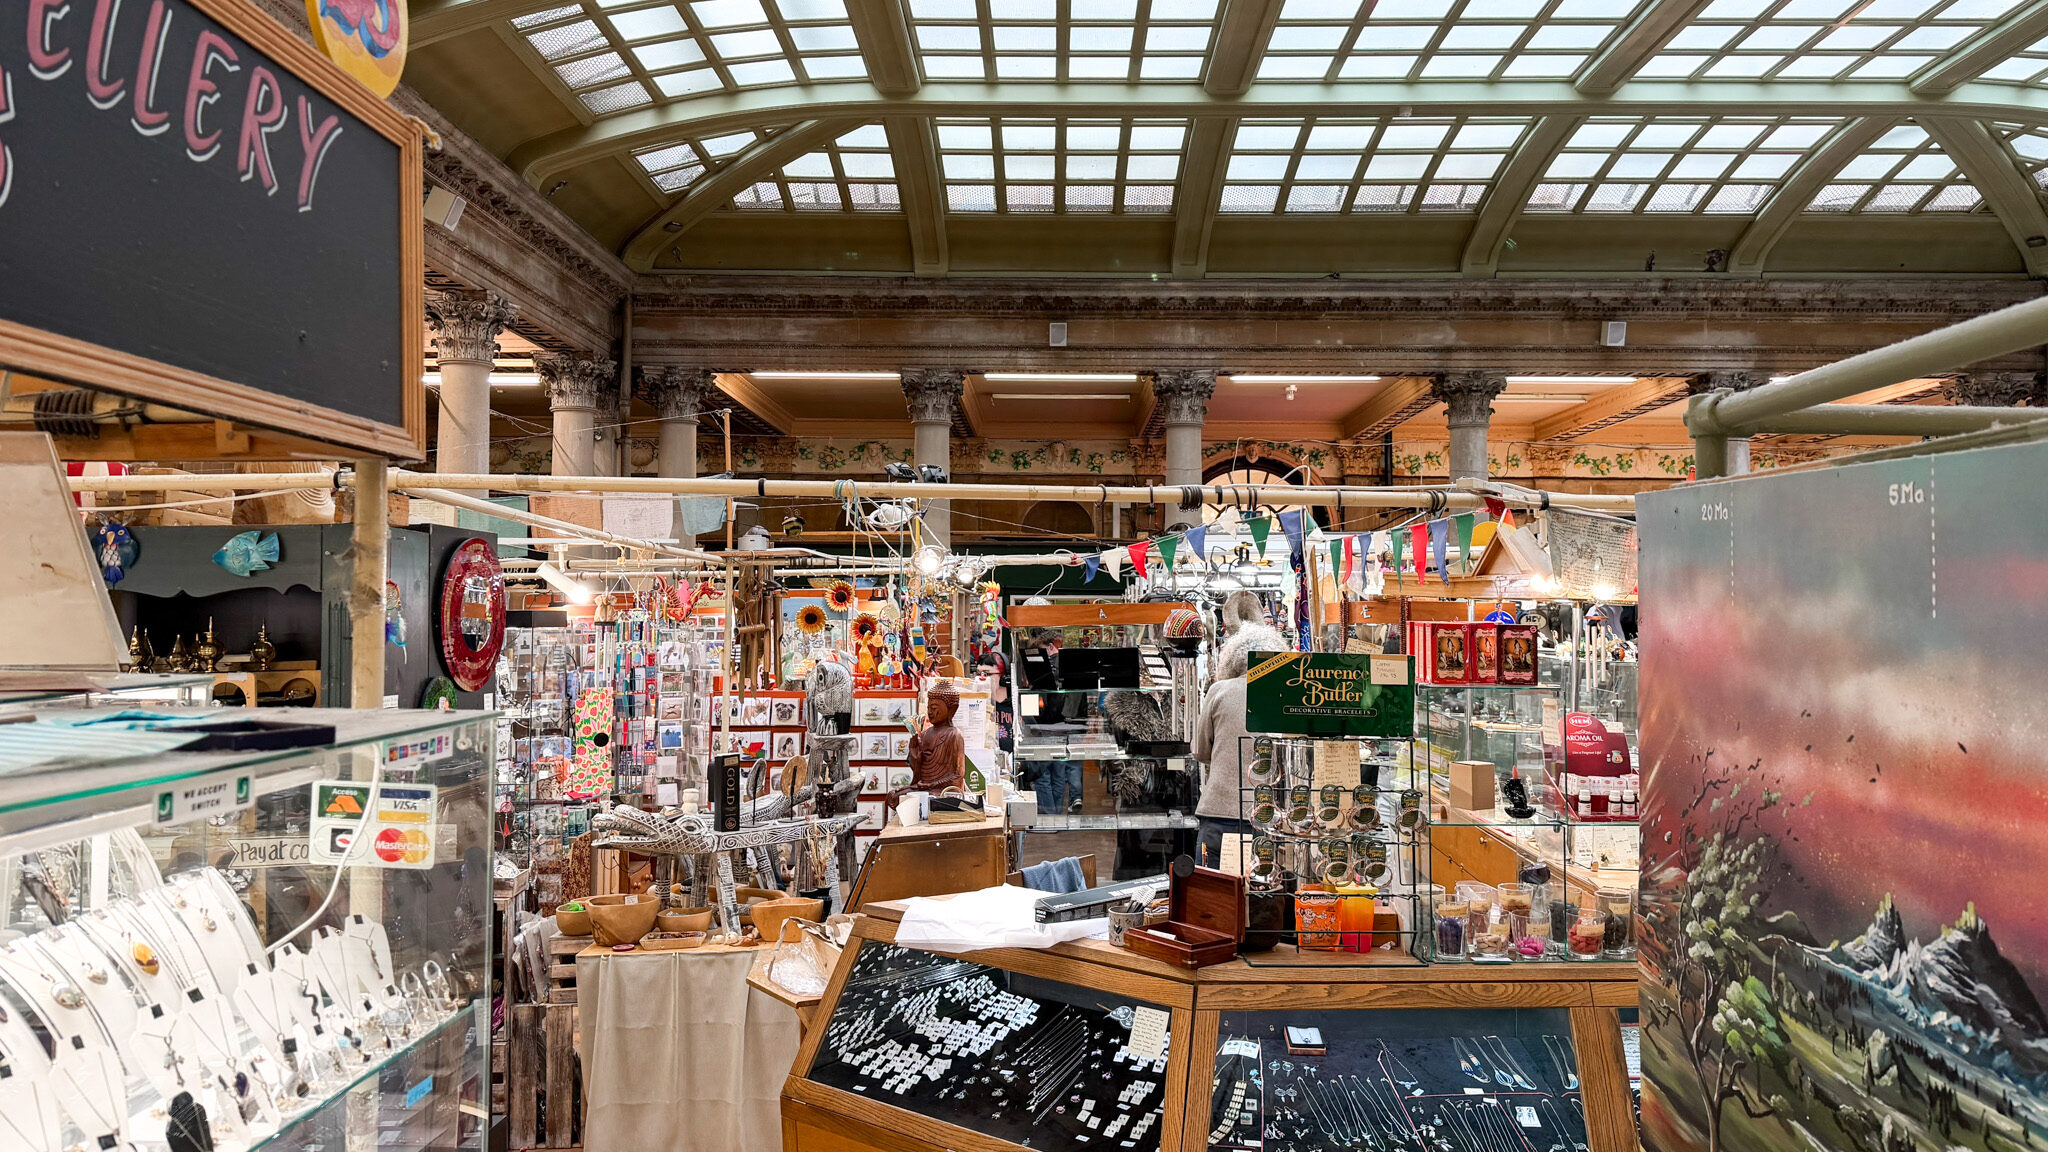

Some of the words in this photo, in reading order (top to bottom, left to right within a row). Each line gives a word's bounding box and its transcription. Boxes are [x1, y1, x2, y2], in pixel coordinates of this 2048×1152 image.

[1249, 654, 1289, 678] THERAPEUTIC
[1286, 654, 1369, 686] Laurence
[1302, 682, 1363, 707] Butler
[184, 790, 195, 799] WE
[197, 783, 227, 797] ACCEPT
[332, 788, 358, 796] Access
[726, 767, 736, 806] GOLD
[191, 799, 220, 812] SWITCH
[393, 800, 417, 810] VISA
[240, 843, 266, 863] Pay
[268, 841, 287, 860] at
[375, 840, 430, 851] MasterCard
